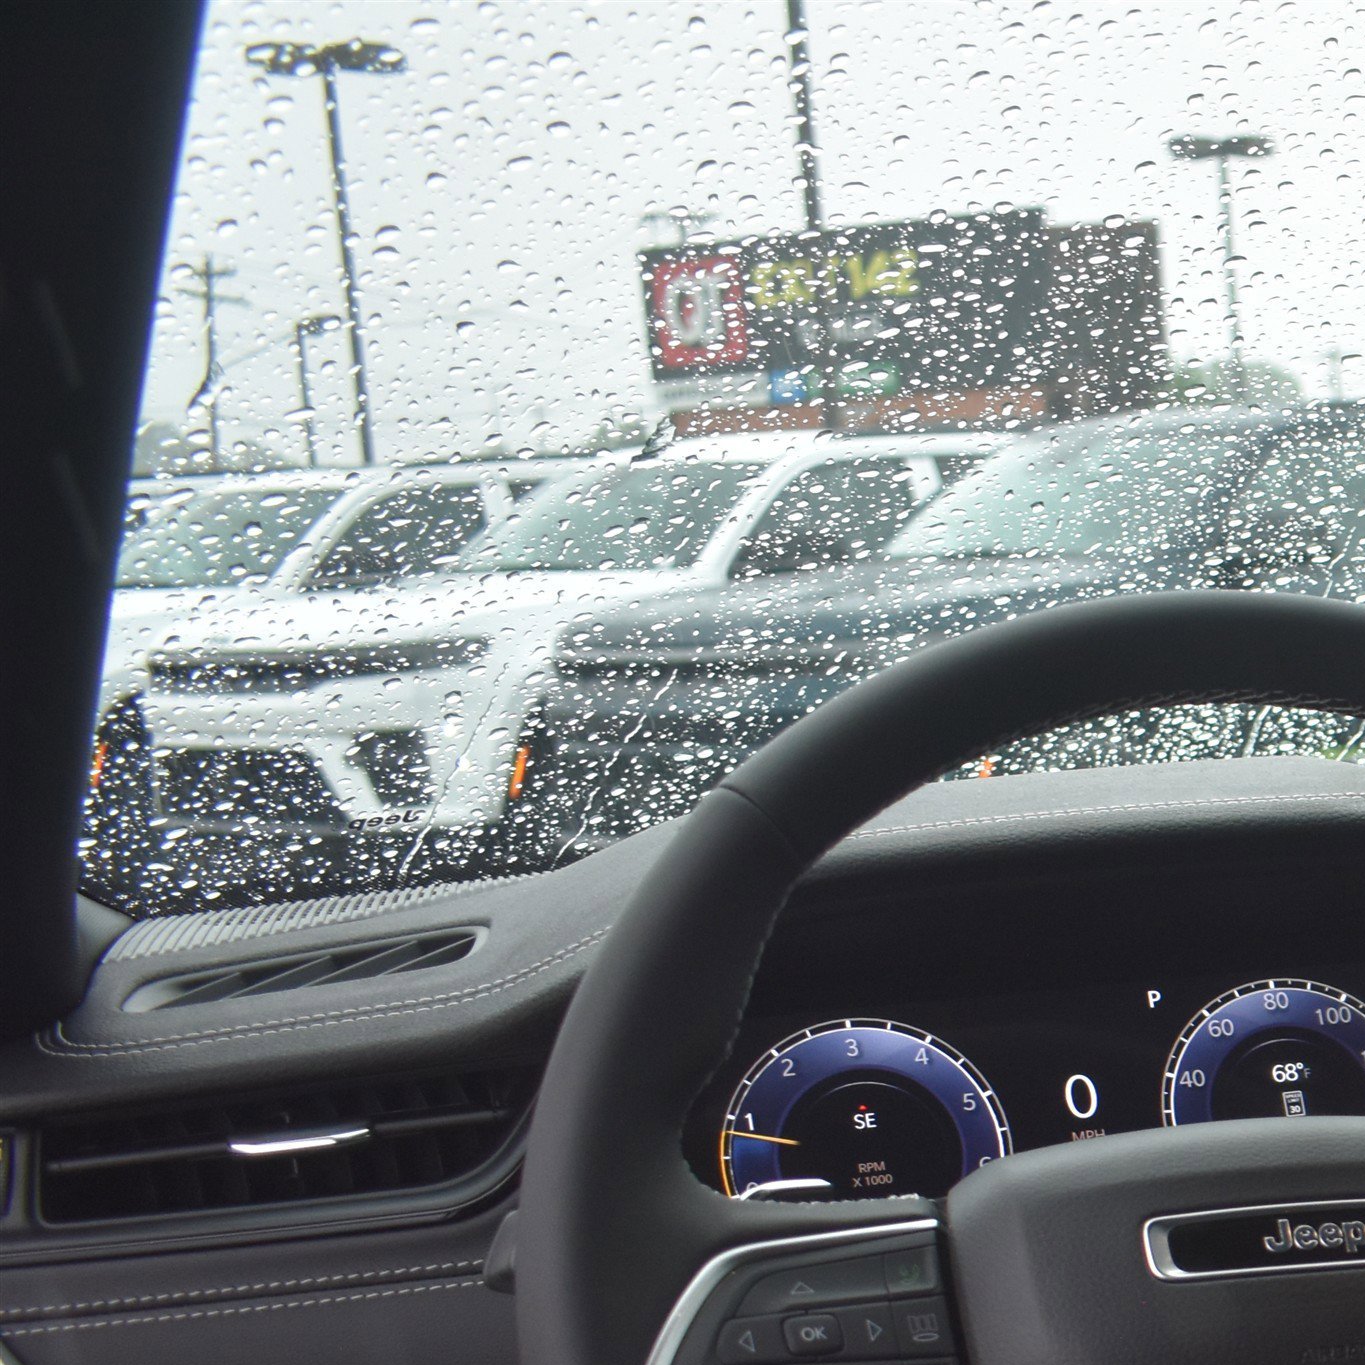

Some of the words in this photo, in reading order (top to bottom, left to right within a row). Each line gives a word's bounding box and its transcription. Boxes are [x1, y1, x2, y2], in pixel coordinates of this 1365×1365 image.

[1147, 990, 1161, 1008] P
[1263, 992, 1289, 1010] 80
[1315, 1007, 1351, 1025] 100
[1208, 1018, 1234, 1038] 60
[846, 1038, 859, 1057] 3
[915, 1047, 930, 1065] 4
[781, 1058, 796, 1077] 2
[1180, 1069, 1205, 1088] 40
[963, 1093, 976, 1111] 5
[1064, 1074, 1098, 1119] 0
[744, 1113, 755, 1131] 1
[853, 1113, 877, 1130] SE
[858, 1160, 886, 1173] RPM
[852, 1176, 863, 1187] X
[865, 1173, 893, 1186] 1000
[801, 1325, 827, 1341] OK
